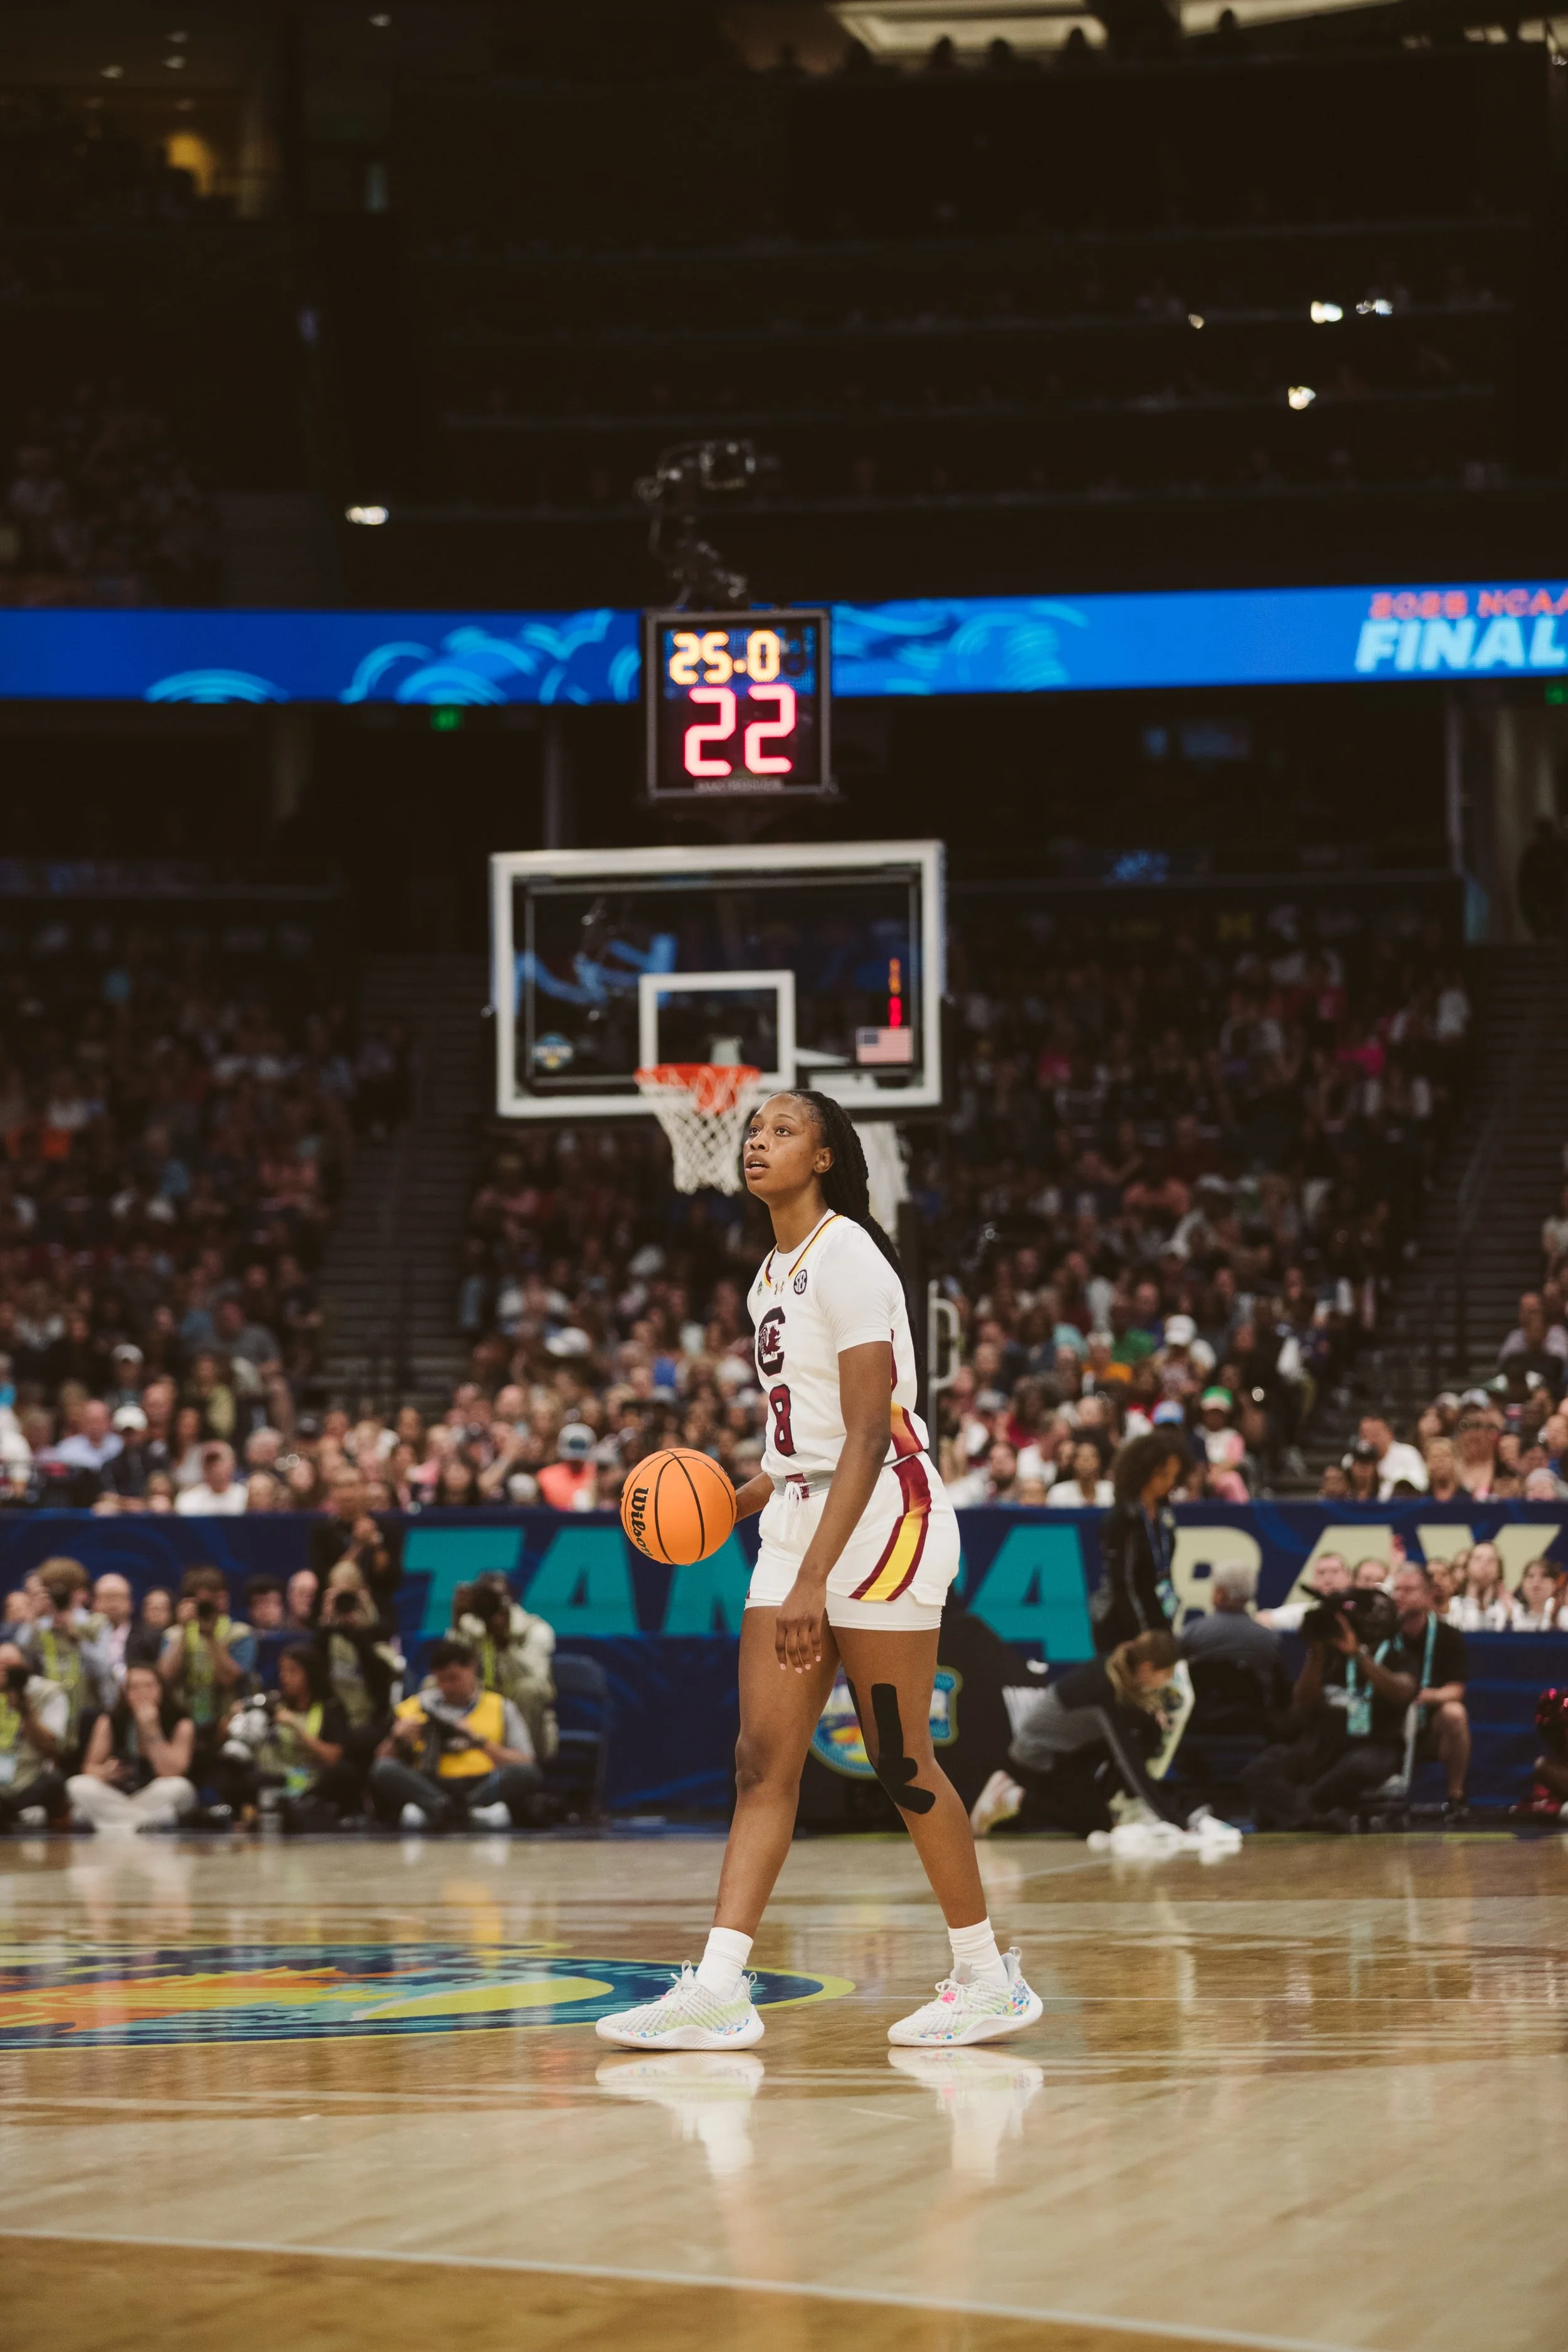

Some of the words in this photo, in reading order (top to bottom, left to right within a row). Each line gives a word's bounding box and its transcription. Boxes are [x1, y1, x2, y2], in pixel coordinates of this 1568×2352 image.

[669, 630, 780, 685] 25.0
[1355, 613, 1567, 673] FINAL
[684, 684, 796, 776] 22
[769, 1384, 797, 1457] 8
[631, 1487, 654, 1557] Wilson
